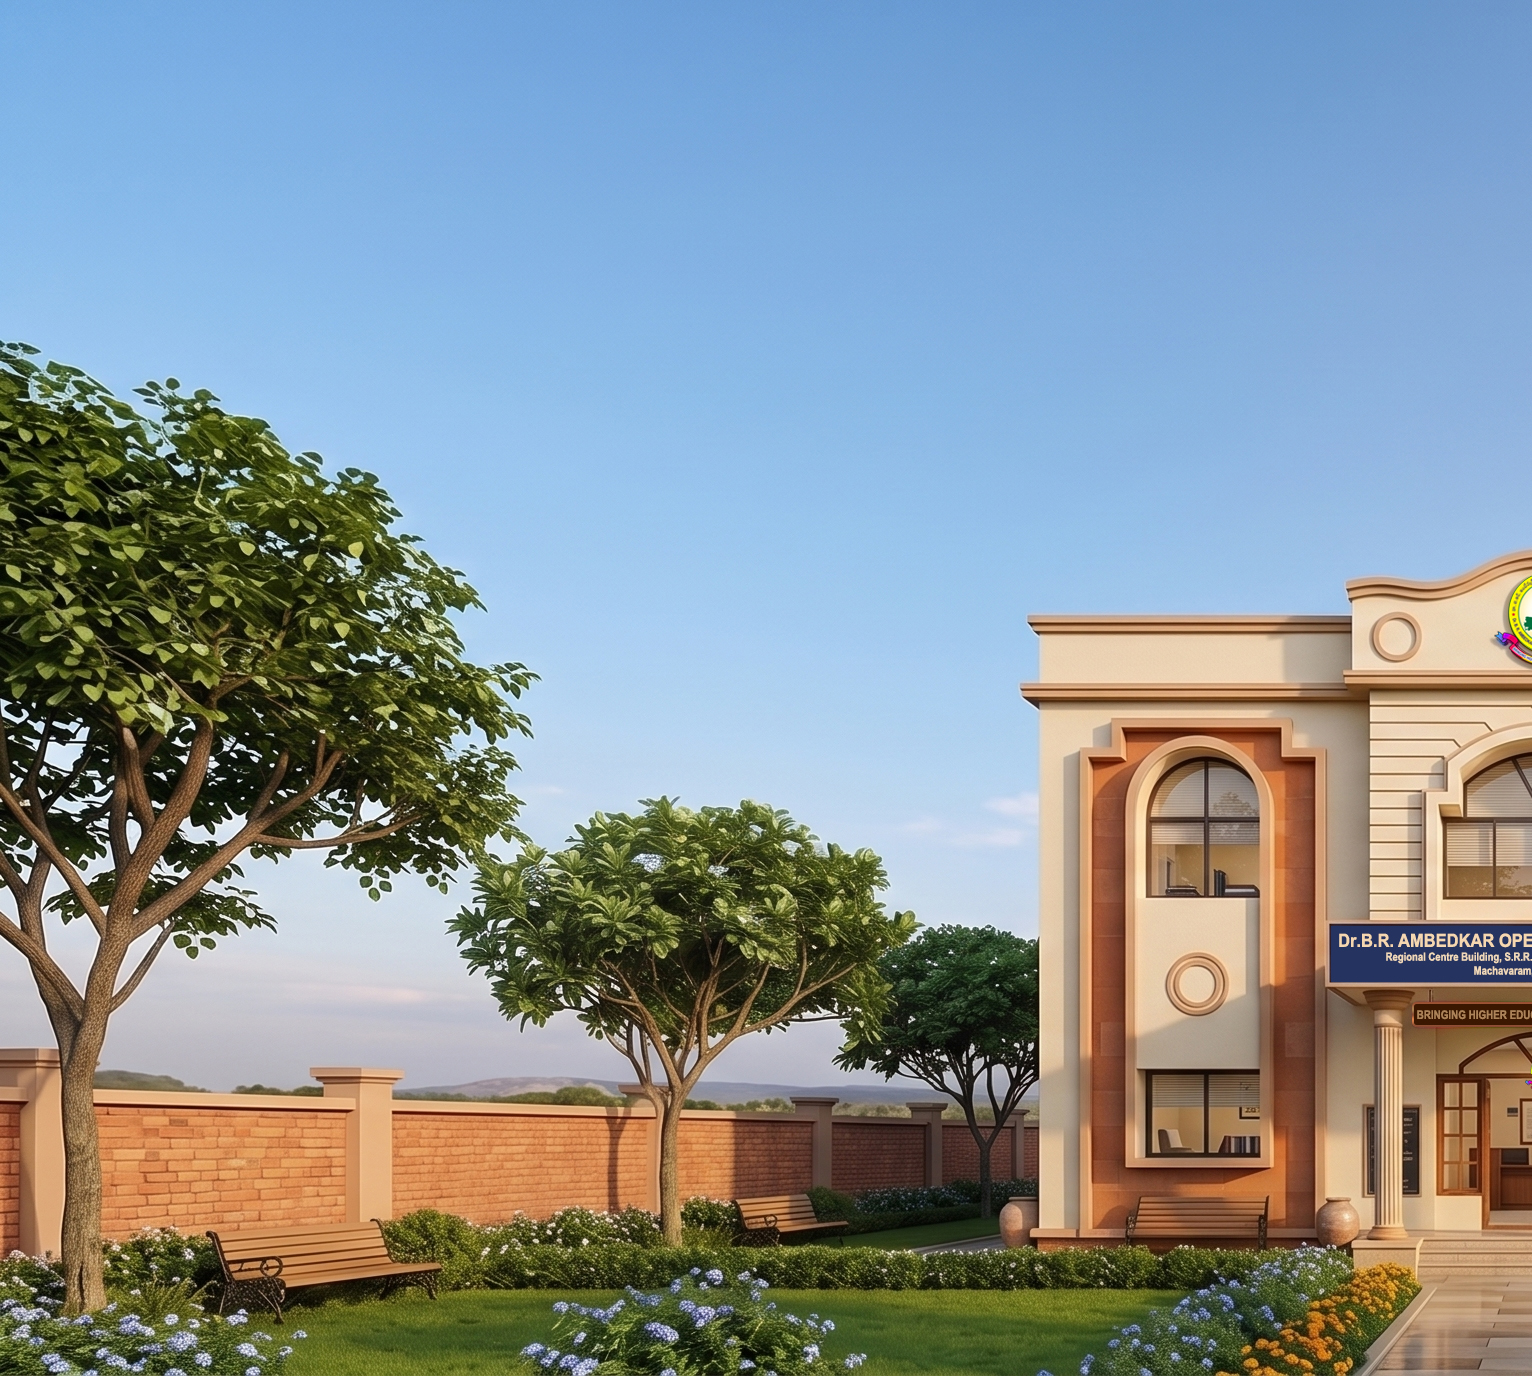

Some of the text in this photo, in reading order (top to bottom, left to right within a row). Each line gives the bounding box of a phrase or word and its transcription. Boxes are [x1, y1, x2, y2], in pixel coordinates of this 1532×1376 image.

[1338, 933, 1393, 948] Dr.B.R.
[1398, 933, 1494, 948] AMBEDKAR
[1386, 952, 1426, 964] Regional
[1429, 952, 1459, 962] Centre
[1462, 952, 1502, 964] Building,
[1505, 952, 1532, 962] S.R.R.
[1417, 1010, 1466, 1020] BRINGING
[1469, 1010, 1508, 1020] HIGHER
